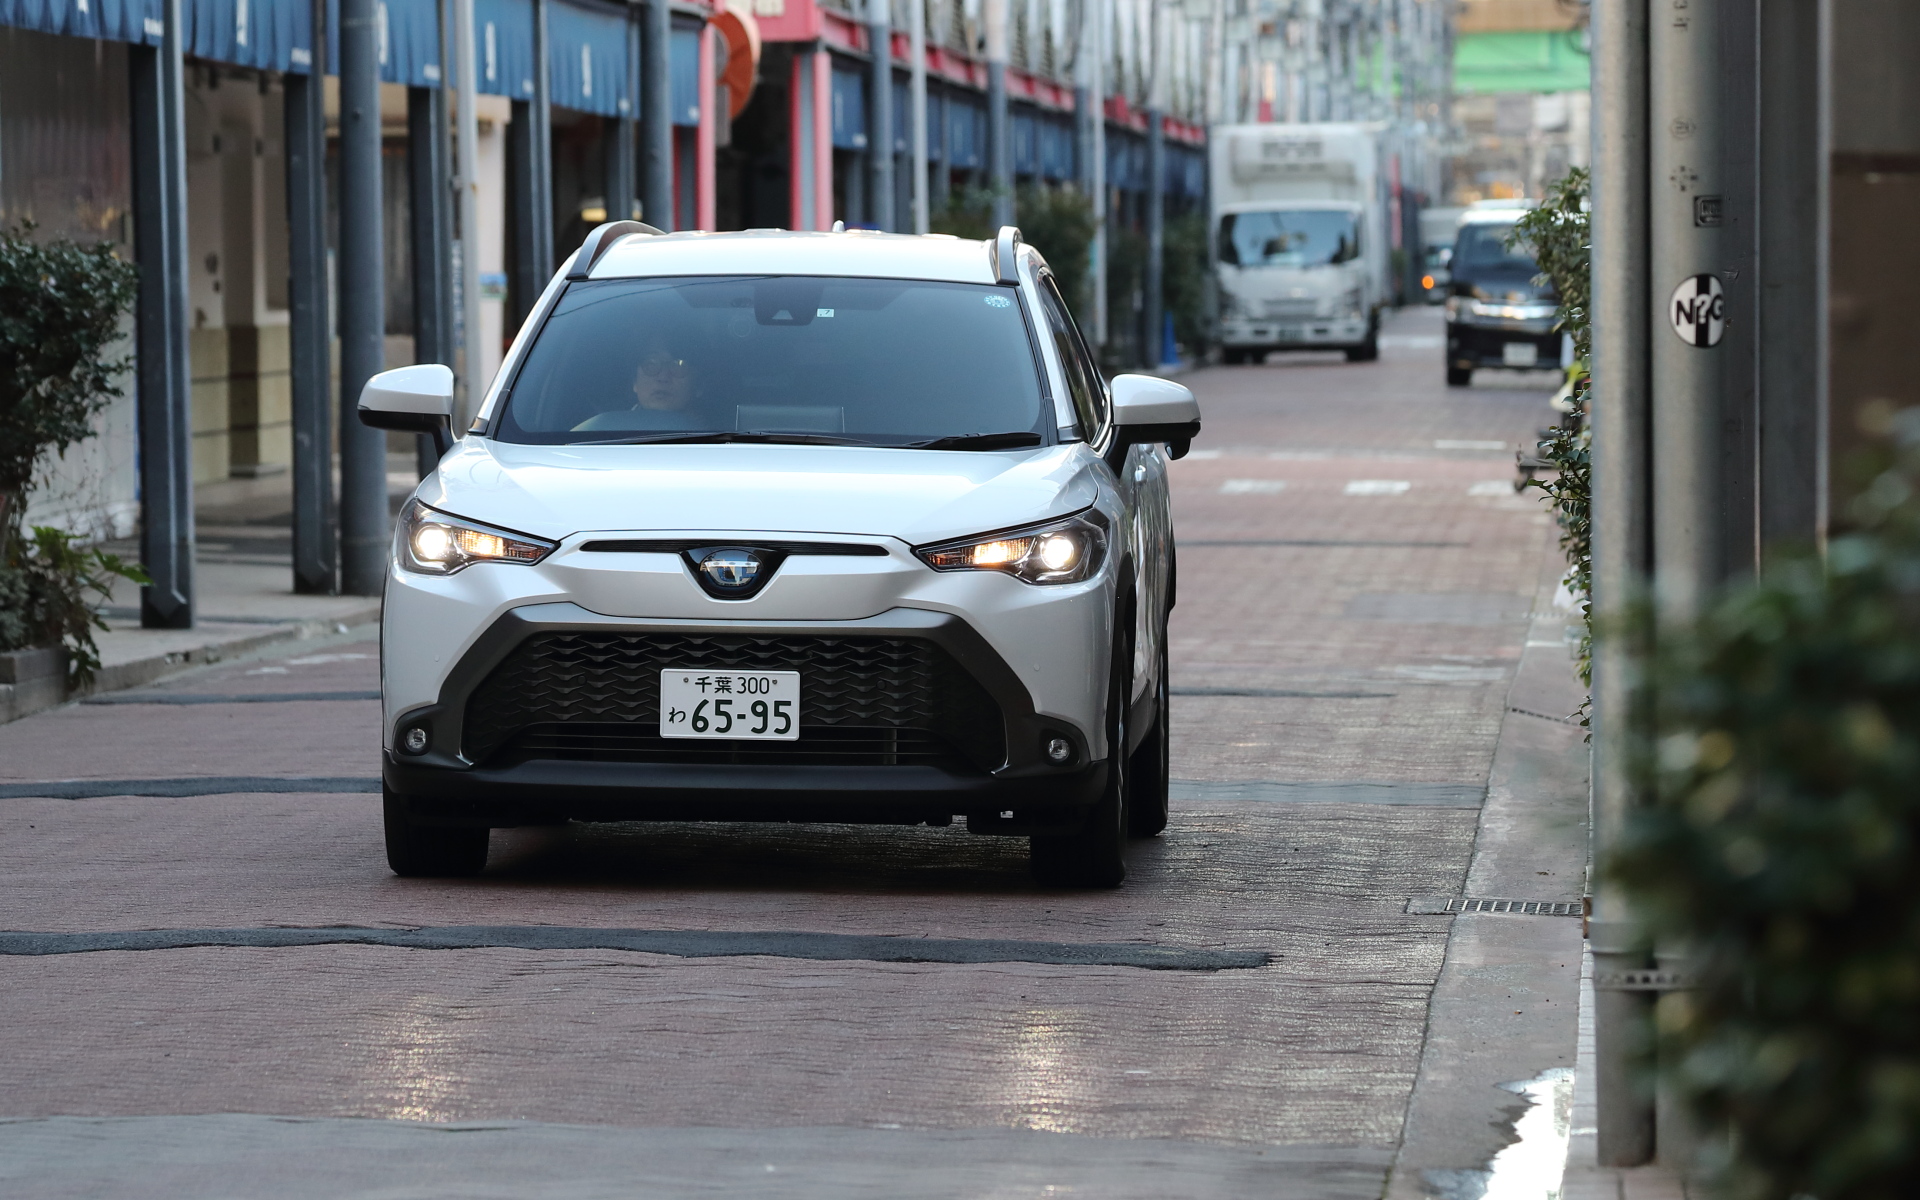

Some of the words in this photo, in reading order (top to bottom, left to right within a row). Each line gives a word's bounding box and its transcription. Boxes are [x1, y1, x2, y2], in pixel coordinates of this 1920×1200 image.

[695, 676, 732, 694] 千葉
[737, 677, 769, 694] 300
[669, 707, 686, 724] わ
[691, 699, 792, 734] 65-95
